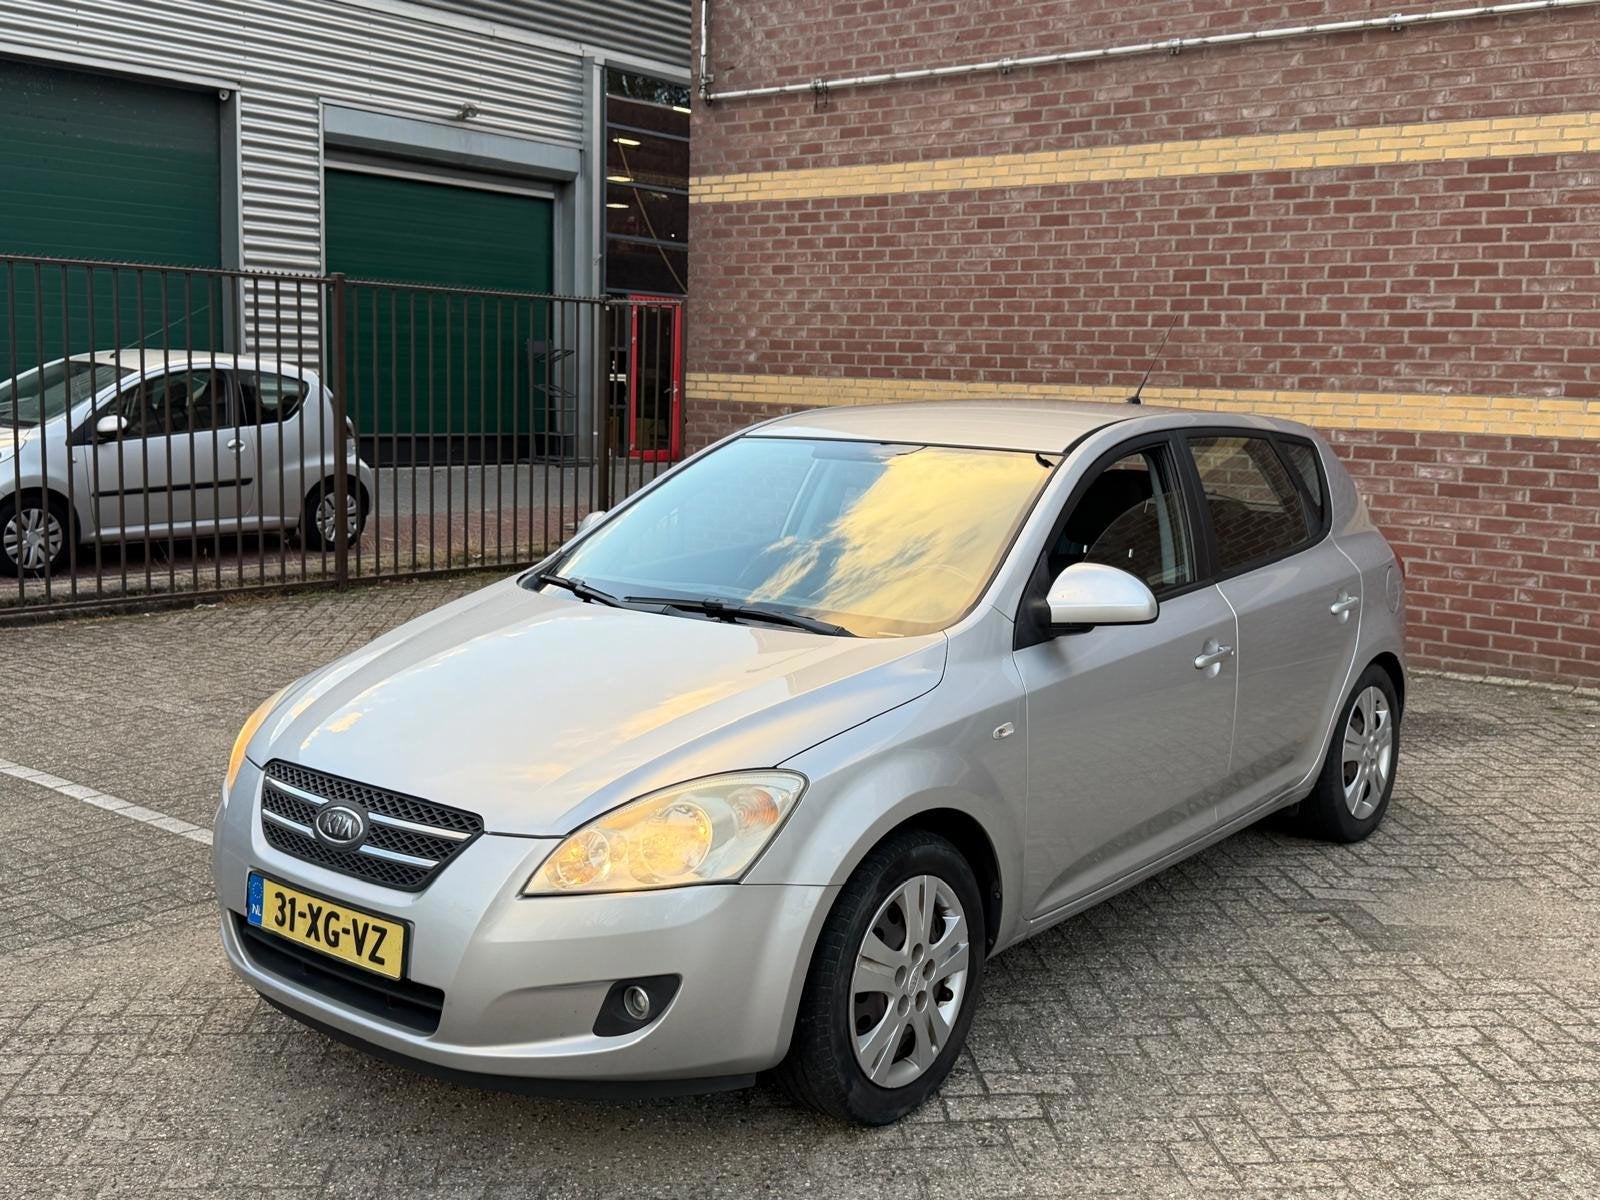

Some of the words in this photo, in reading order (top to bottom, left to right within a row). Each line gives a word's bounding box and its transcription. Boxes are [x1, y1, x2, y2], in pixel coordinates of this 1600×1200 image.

[323, 812, 356, 839] KIA
[252, 904, 262, 917] NL
[274, 891, 388, 966] 31-XG-VZ
